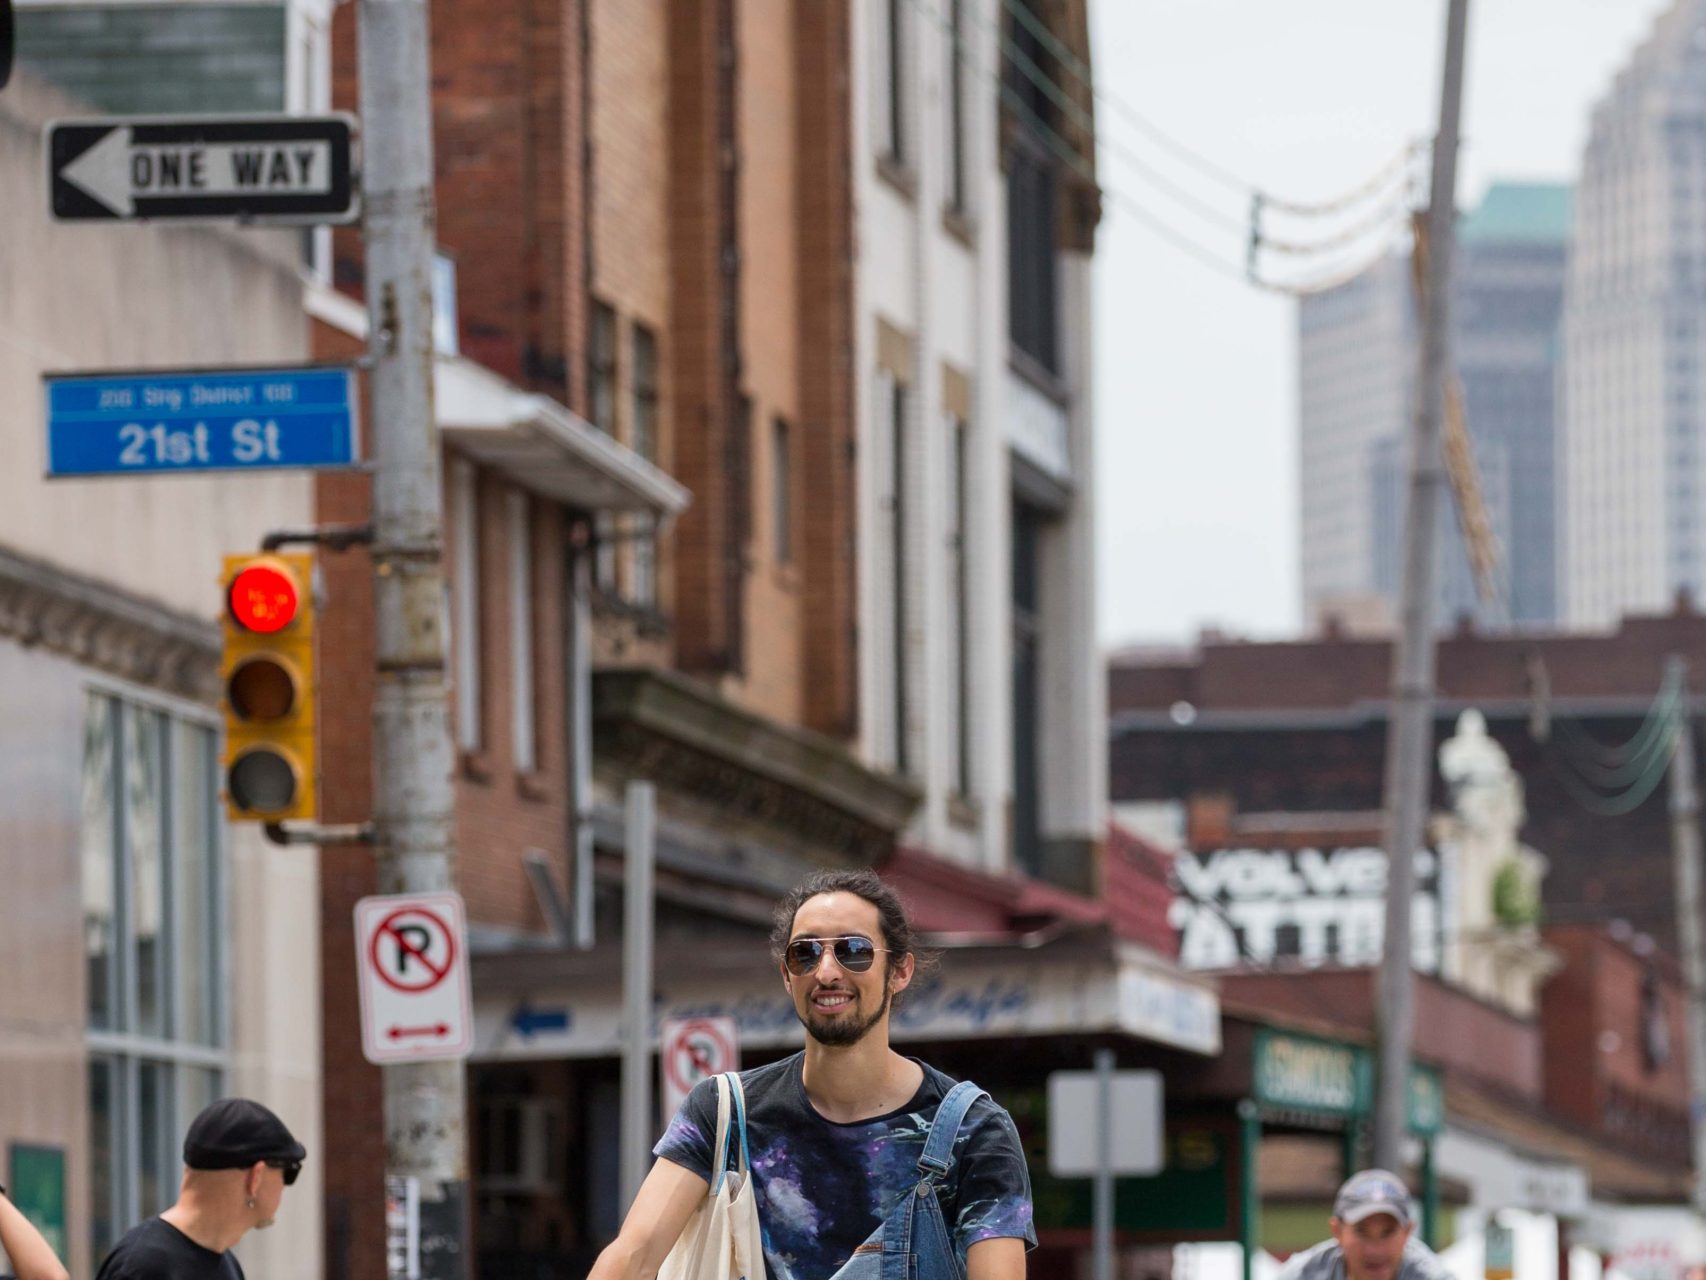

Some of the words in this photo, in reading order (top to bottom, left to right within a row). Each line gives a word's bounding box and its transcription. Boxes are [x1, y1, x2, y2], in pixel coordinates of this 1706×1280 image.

[132, 150, 208, 189] ONE
[230, 148, 316, 187] WAY
[119, 422, 210, 465] 21st
[231, 418, 282, 462] St
